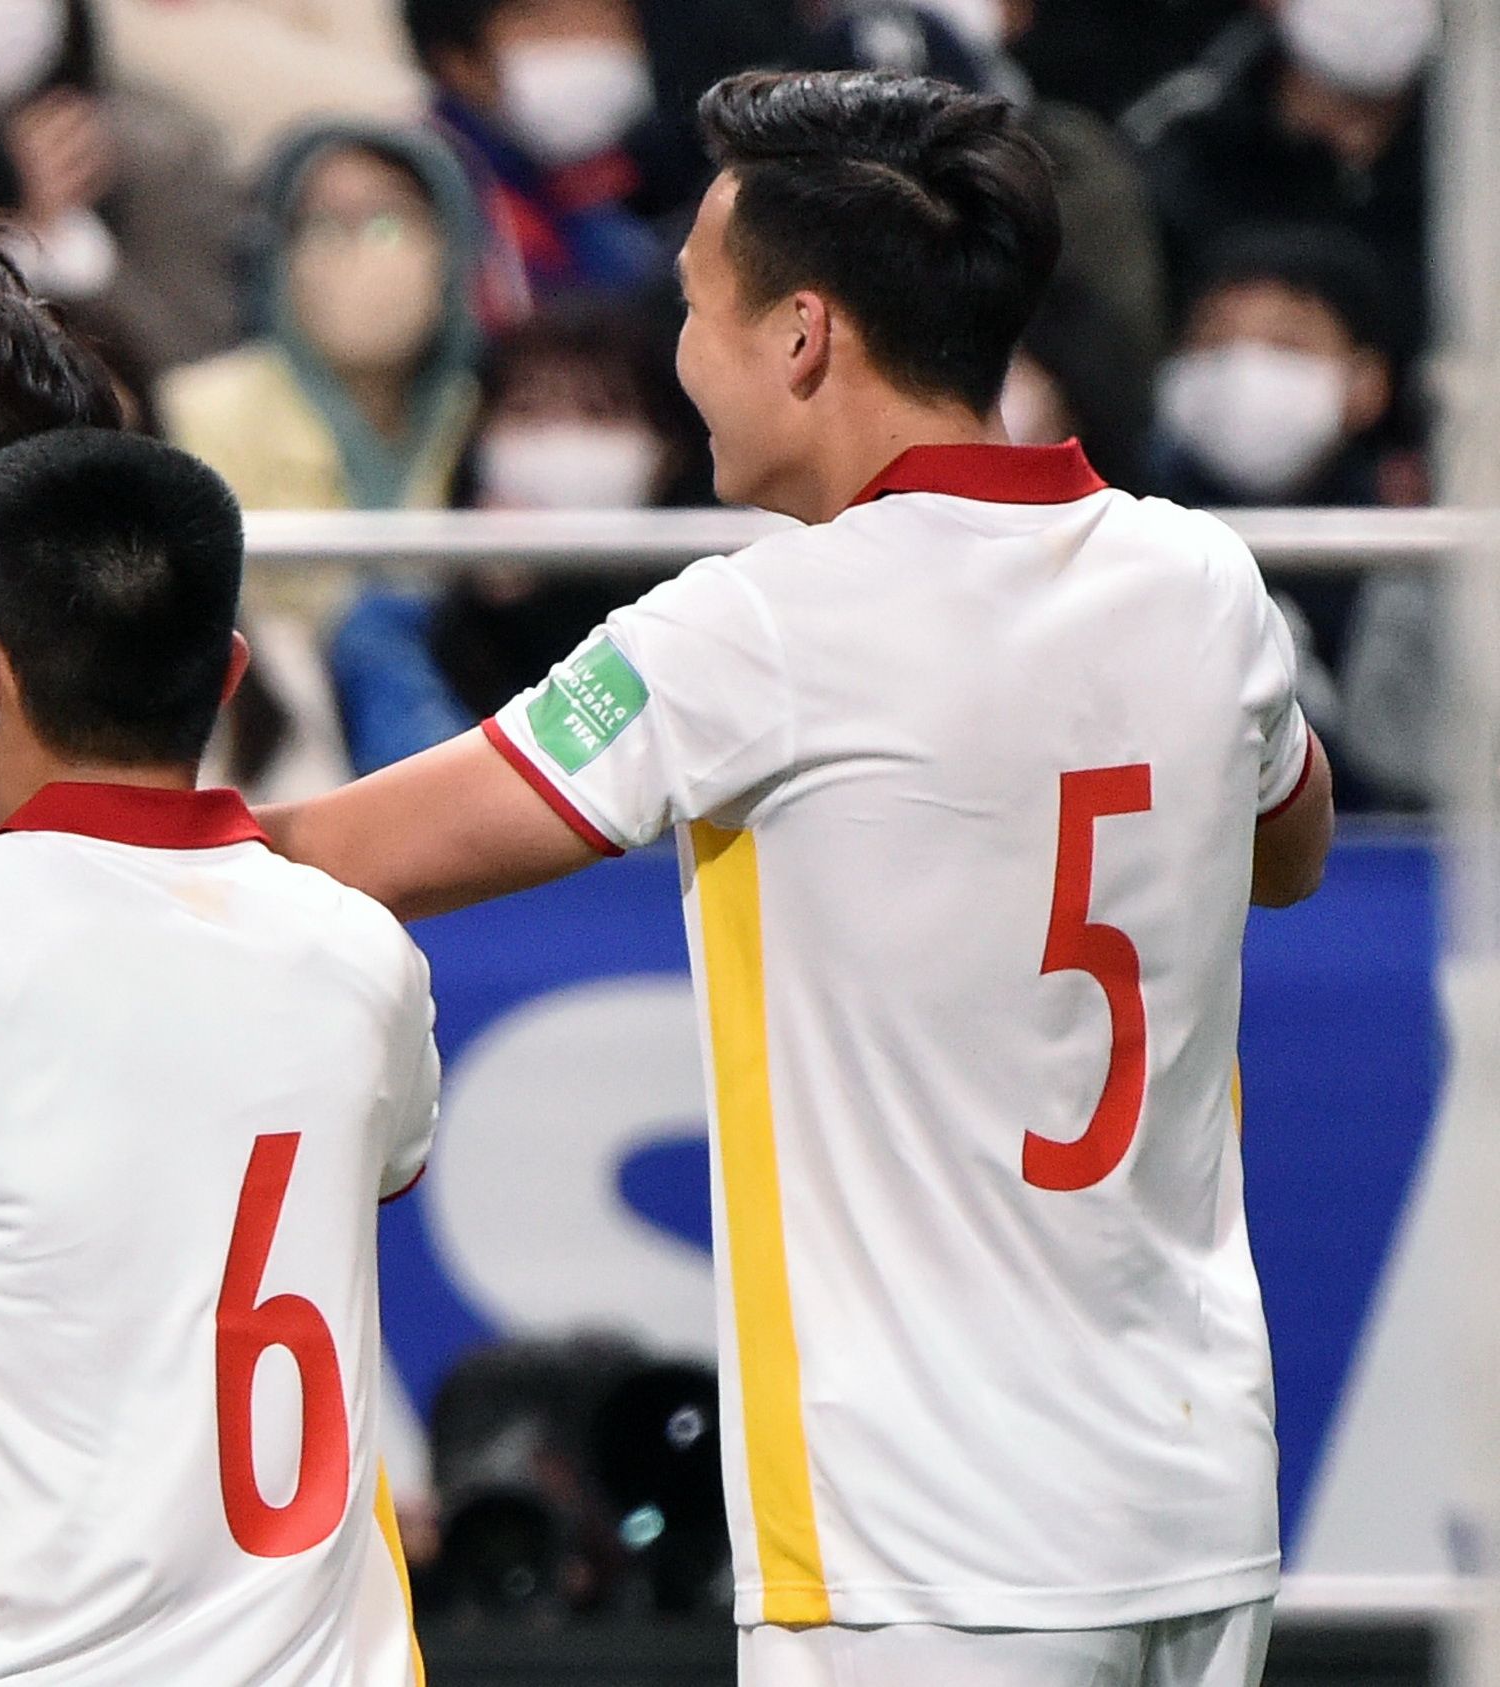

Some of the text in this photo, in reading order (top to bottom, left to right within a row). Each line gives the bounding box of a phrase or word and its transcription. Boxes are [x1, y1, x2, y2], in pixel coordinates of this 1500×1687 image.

[562, 712, 602, 752] FIFA
[1022, 762, 1152, 1192] 5
[215, 1131, 350, 1558] 6
